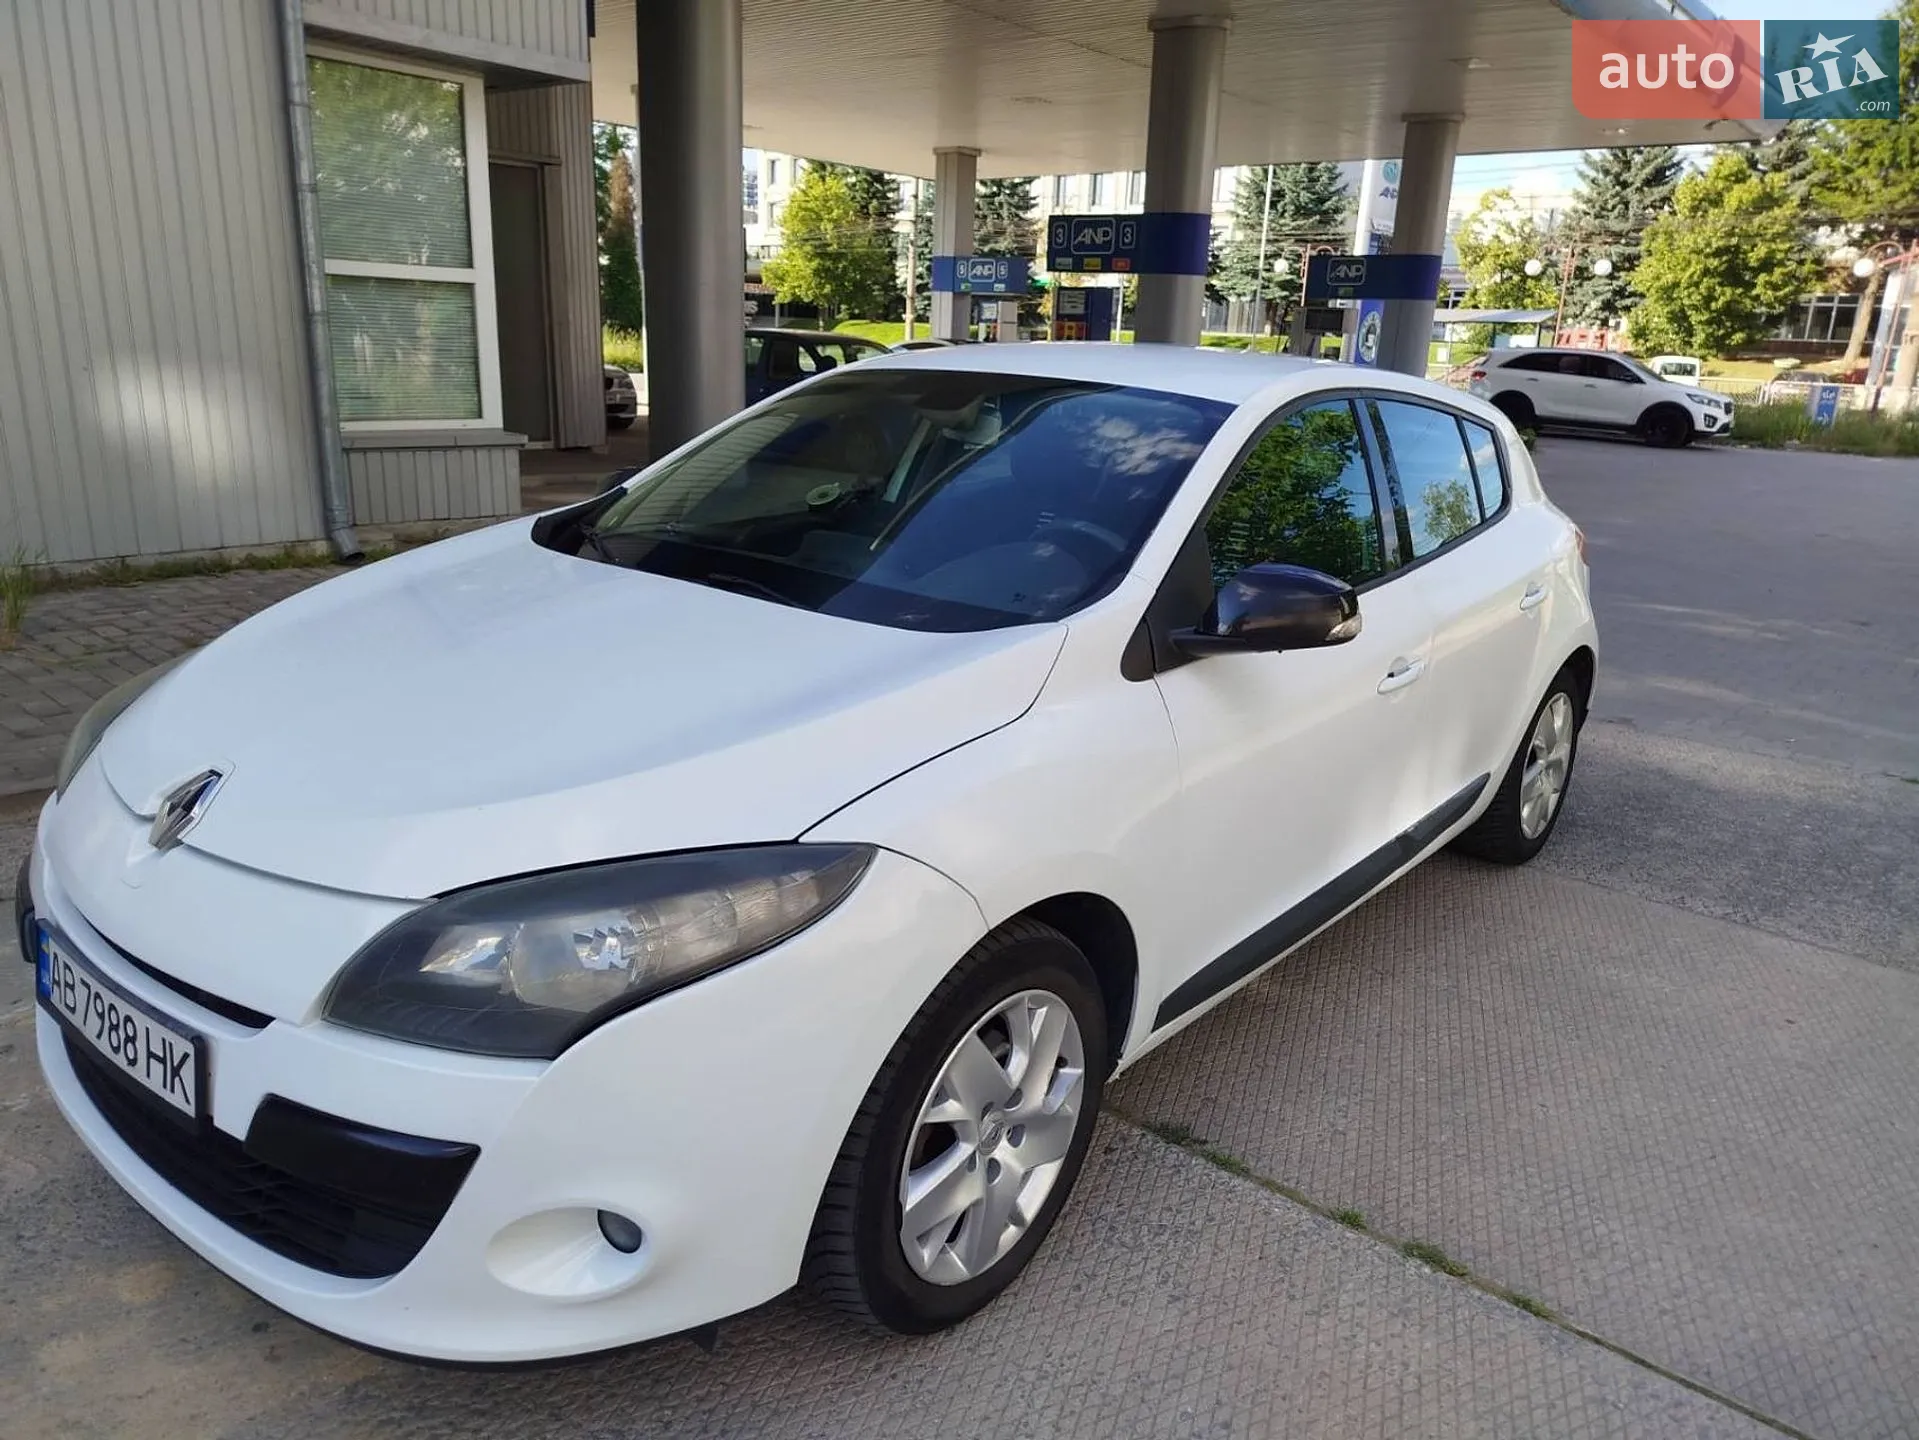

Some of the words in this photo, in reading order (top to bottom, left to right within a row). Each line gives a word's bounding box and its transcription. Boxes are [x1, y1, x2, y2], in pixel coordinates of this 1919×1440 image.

[1056, 228, 1064, 243] 3
[1074, 227, 1112, 245] ANP
[1124, 228, 1132, 243] 3
[1330, 264, 1364, 279] ANP
[51, 951, 77, 1016] AB
[80, 979, 138, 1067] 7988
[146, 1026, 191, 1106] HK
